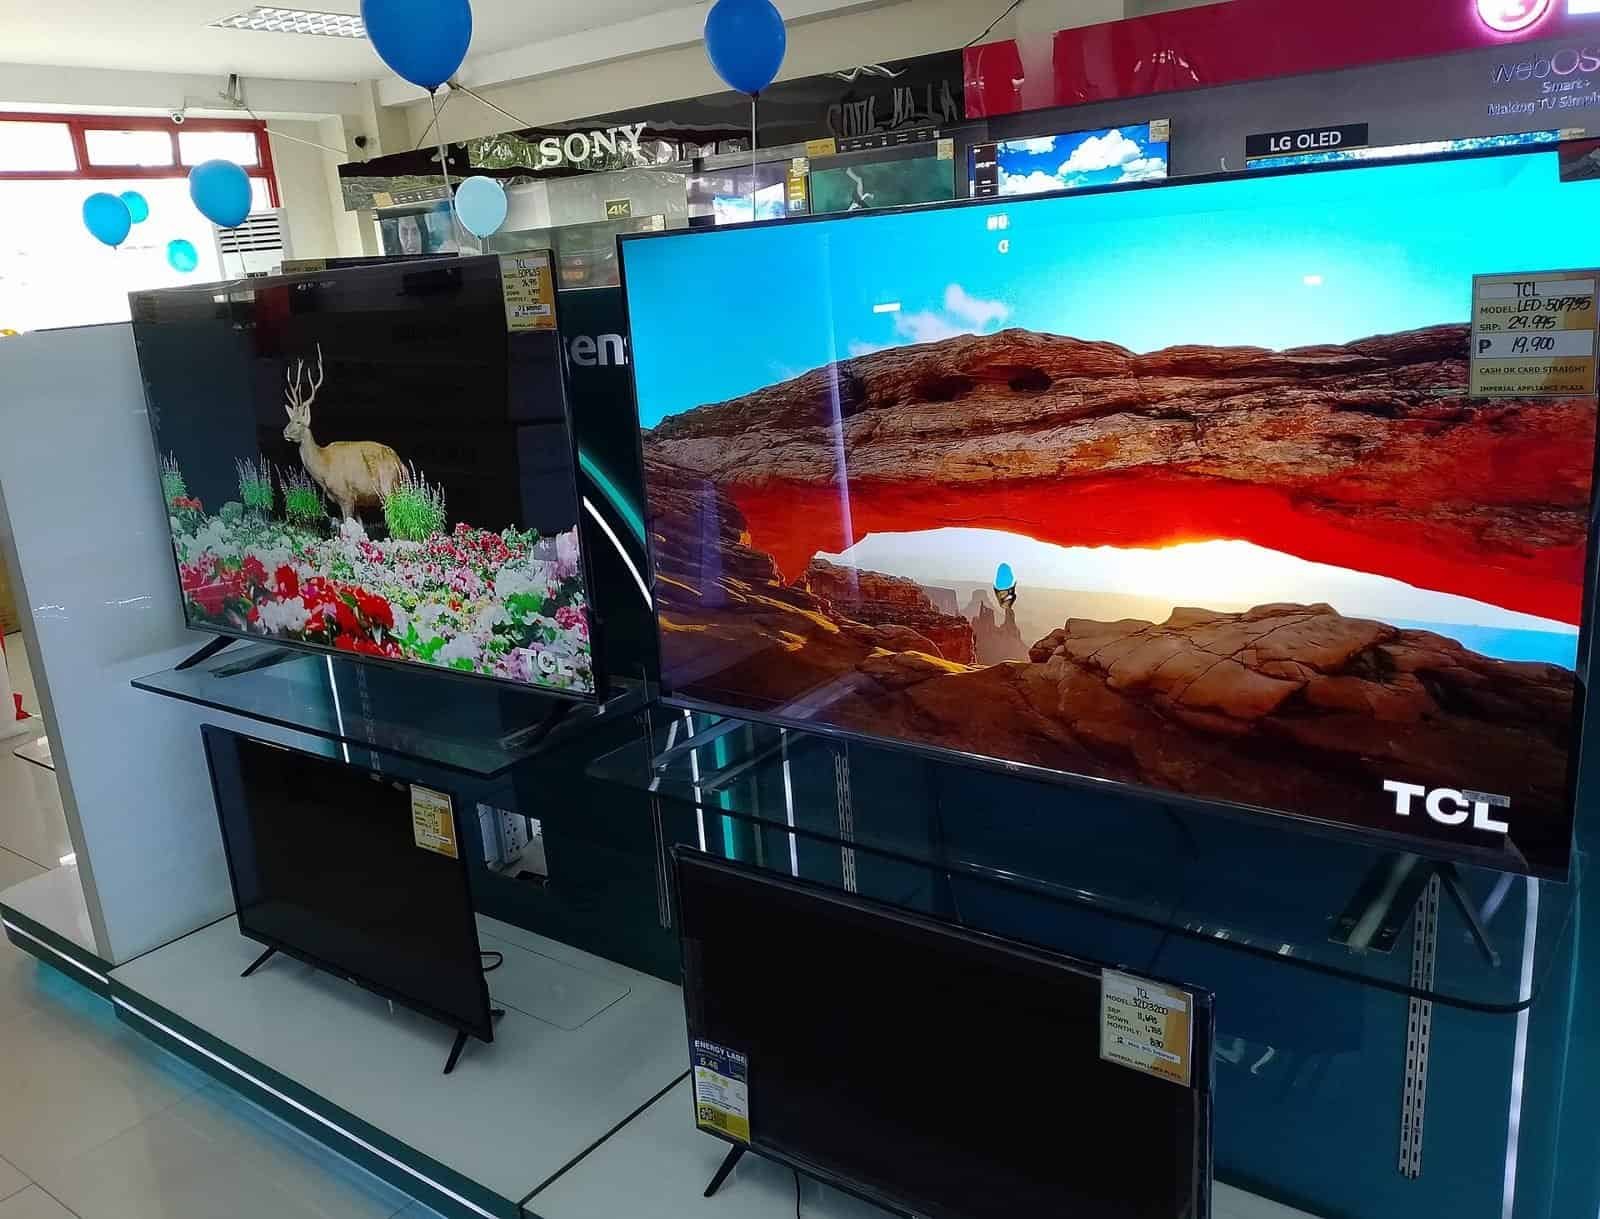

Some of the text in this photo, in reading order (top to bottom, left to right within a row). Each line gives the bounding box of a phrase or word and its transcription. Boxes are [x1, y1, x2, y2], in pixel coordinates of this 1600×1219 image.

[1488, 101, 1536, 116] Making
[1537, 97, 1557, 110] TV
[539, 121, 648, 169] SONY
[1270, 131, 1342, 152] LG OLED
[607, 203, 631, 216] 4K
[1513, 281, 1541, 298] TCL
[1480, 305, 1517, 314] MODEL:
[1479, 322, 1501, 332] SRP:
[571, 333, 629, 367] en
[1478, 338, 1493, 354] P
[1479, 364, 1587, 375] CASH OR CARD STRAIGHT
[1480, 384, 1516, 393] IMPERIAL
[1517, 383, 1558, 393] APPLIANCE
[1383, 779, 1509, 833] TCL
[694, 1039, 725, 1056] ENERGY
